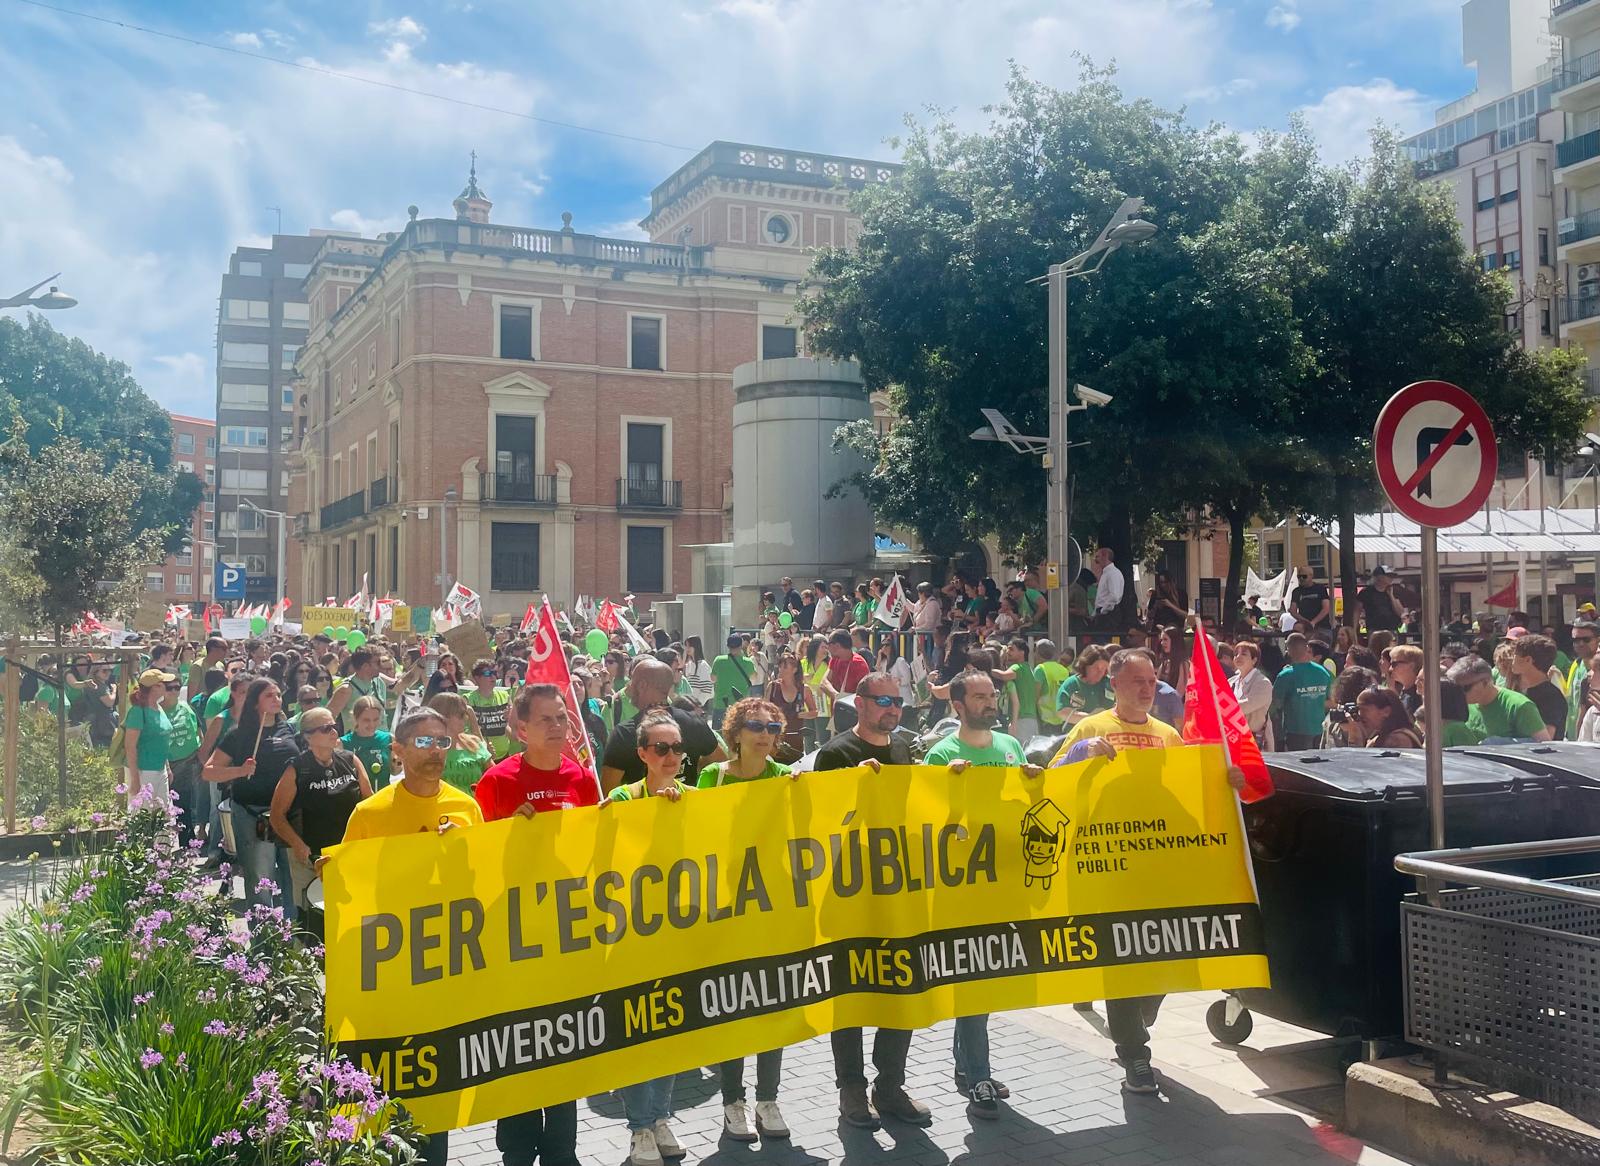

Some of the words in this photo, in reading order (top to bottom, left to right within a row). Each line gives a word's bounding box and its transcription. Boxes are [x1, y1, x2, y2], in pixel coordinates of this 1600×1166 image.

[223, 569, 239, 588] P
[526, 791, 545, 800] UGT
[1077, 818, 1166, 838] PLATAFORMA
[1075, 841, 1101, 856] PER
[1106, 832, 1228, 853] L'ENSENYAMENT
[1077, 856, 1128, 874] PÚBLIC
[361, 898, 486, 991] PER
[508, 846, 773, 962] L'ESCOLA
[787, 810, 998, 908] PÚBLICA
[361, 1036, 438, 1092] MÉS
[459, 994, 606, 1079] INVERSIÓ
[624, 979, 685, 1038] MÉS
[700, 954, 833, 1018] QUALITAT
[849, 939, 913, 987] MÉS
[919, 922, 1028, 982] VALENCIÀ
[1040, 917, 1098, 965] MÉS
[1112, 914, 1241, 958] DIGNITAT
